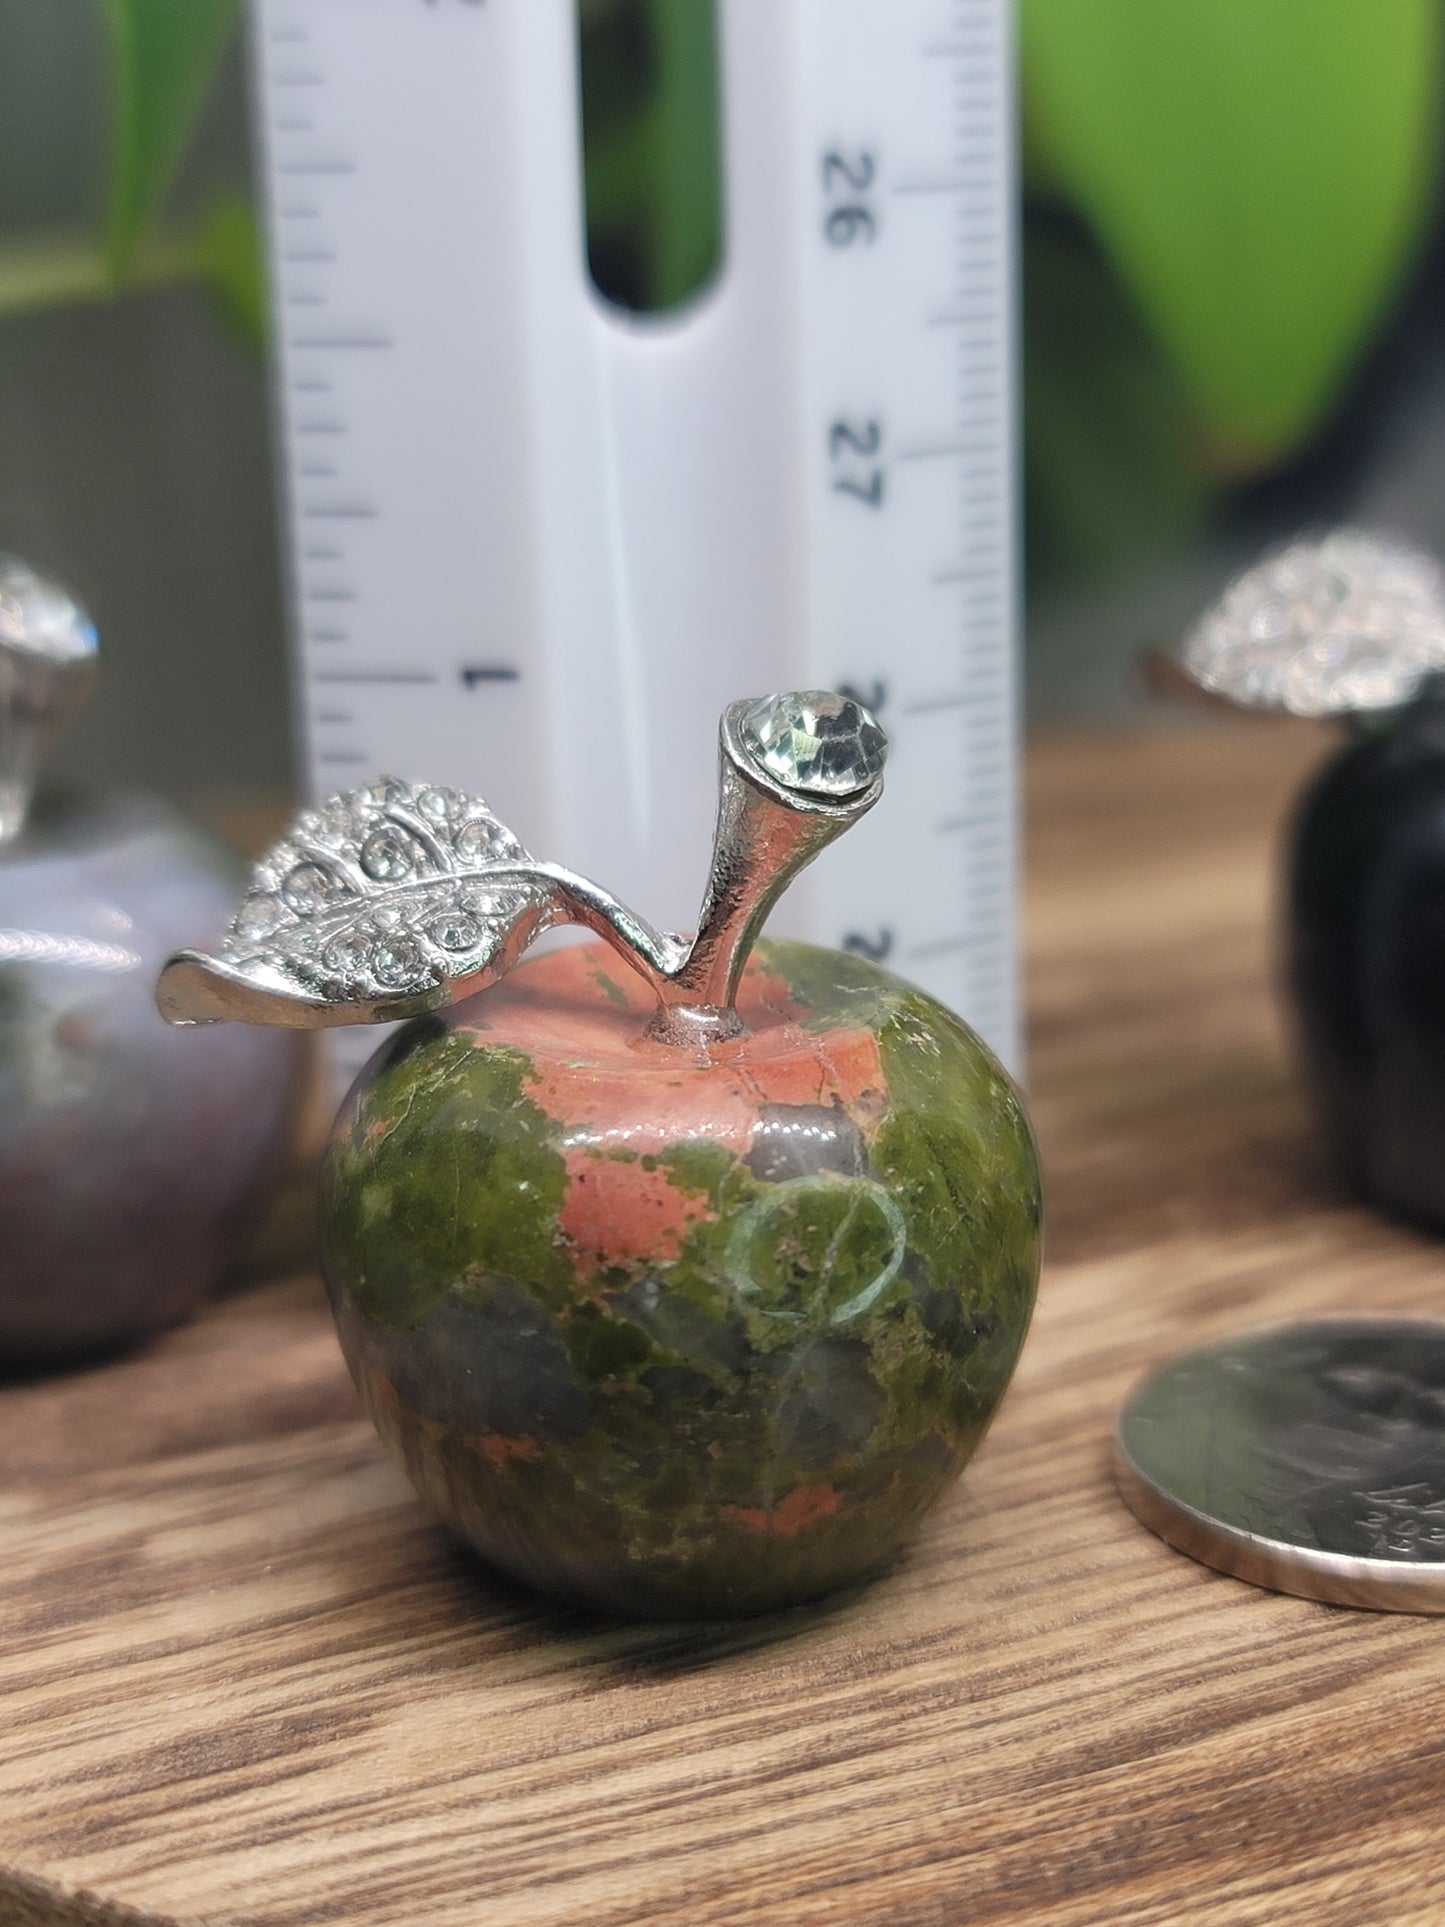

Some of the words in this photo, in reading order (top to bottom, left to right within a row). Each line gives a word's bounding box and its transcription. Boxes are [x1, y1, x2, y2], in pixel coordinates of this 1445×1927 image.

[821, 149, 877, 249] 26
[828, 420, 884, 511] 27
[461, 665, 521, 692] 1
